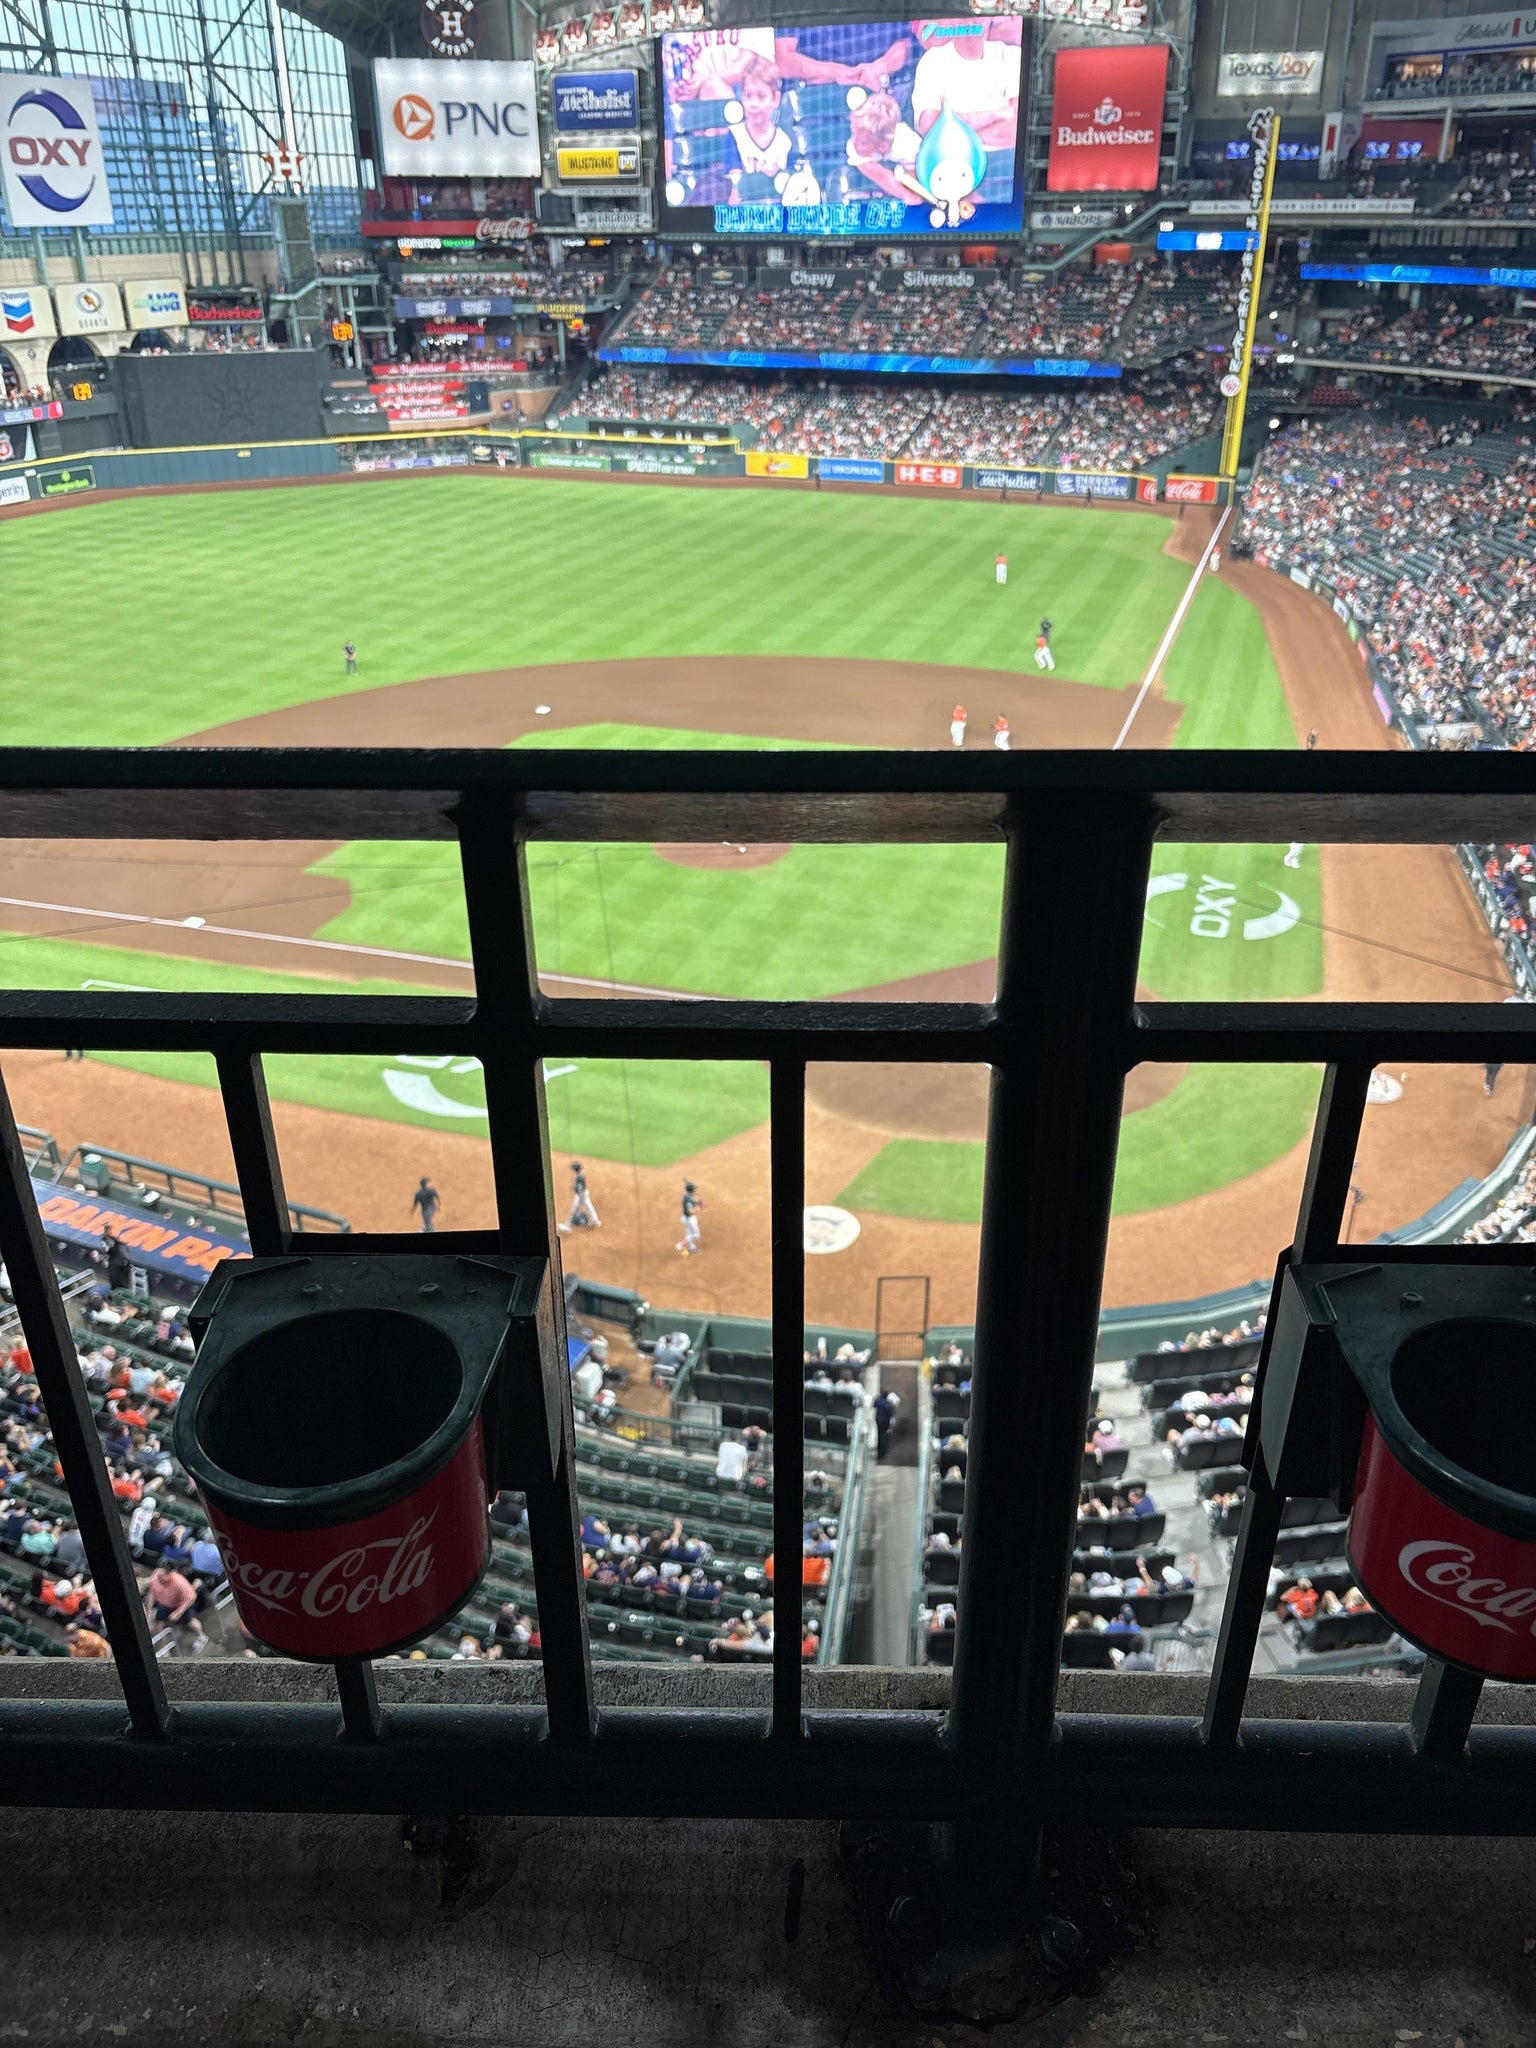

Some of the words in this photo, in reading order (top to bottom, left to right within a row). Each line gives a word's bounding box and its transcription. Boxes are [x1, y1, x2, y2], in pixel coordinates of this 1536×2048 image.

[440, 11, 464, 37] H
[934, 24, 984, 38] DAIKIN
[430, 37, 475, 57] ASTROS
[1228, 57, 1274, 77] Texas
[1280, 54, 1317, 80] Bay
[559, 88, 633, 112] Methodist
[440, 101, 529, 137] PNC
[1057, 126, 1154, 147] Budweiser
[8, 136, 91, 167] OXY
[271, 151, 302, 182] H
[715, 204, 784, 232] DAIKIN
[865, 201, 906, 228] OFF
[476, 217, 537, 240] Coca-Cola
[790, 271, 835, 288] Chevy
[903, 271, 975, 287] Silverado
[189, 306, 262, 320] Budweiser
[400, 364, 447, 375] Budweiser
[471, 361, 514, 372] Budweiser
[398, 383, 445, 393] Budweiser
[410, 408, 458, 419] Budweiser
[899, 465, 959, 483] H-E-B
[1075, 484, 1128, 496] TRNSFER
[1190, 874, 1237, 939] OXY
[40, 1196, 179, 1252] DAIKIN
[161, 1235, 254, 1272] PA
